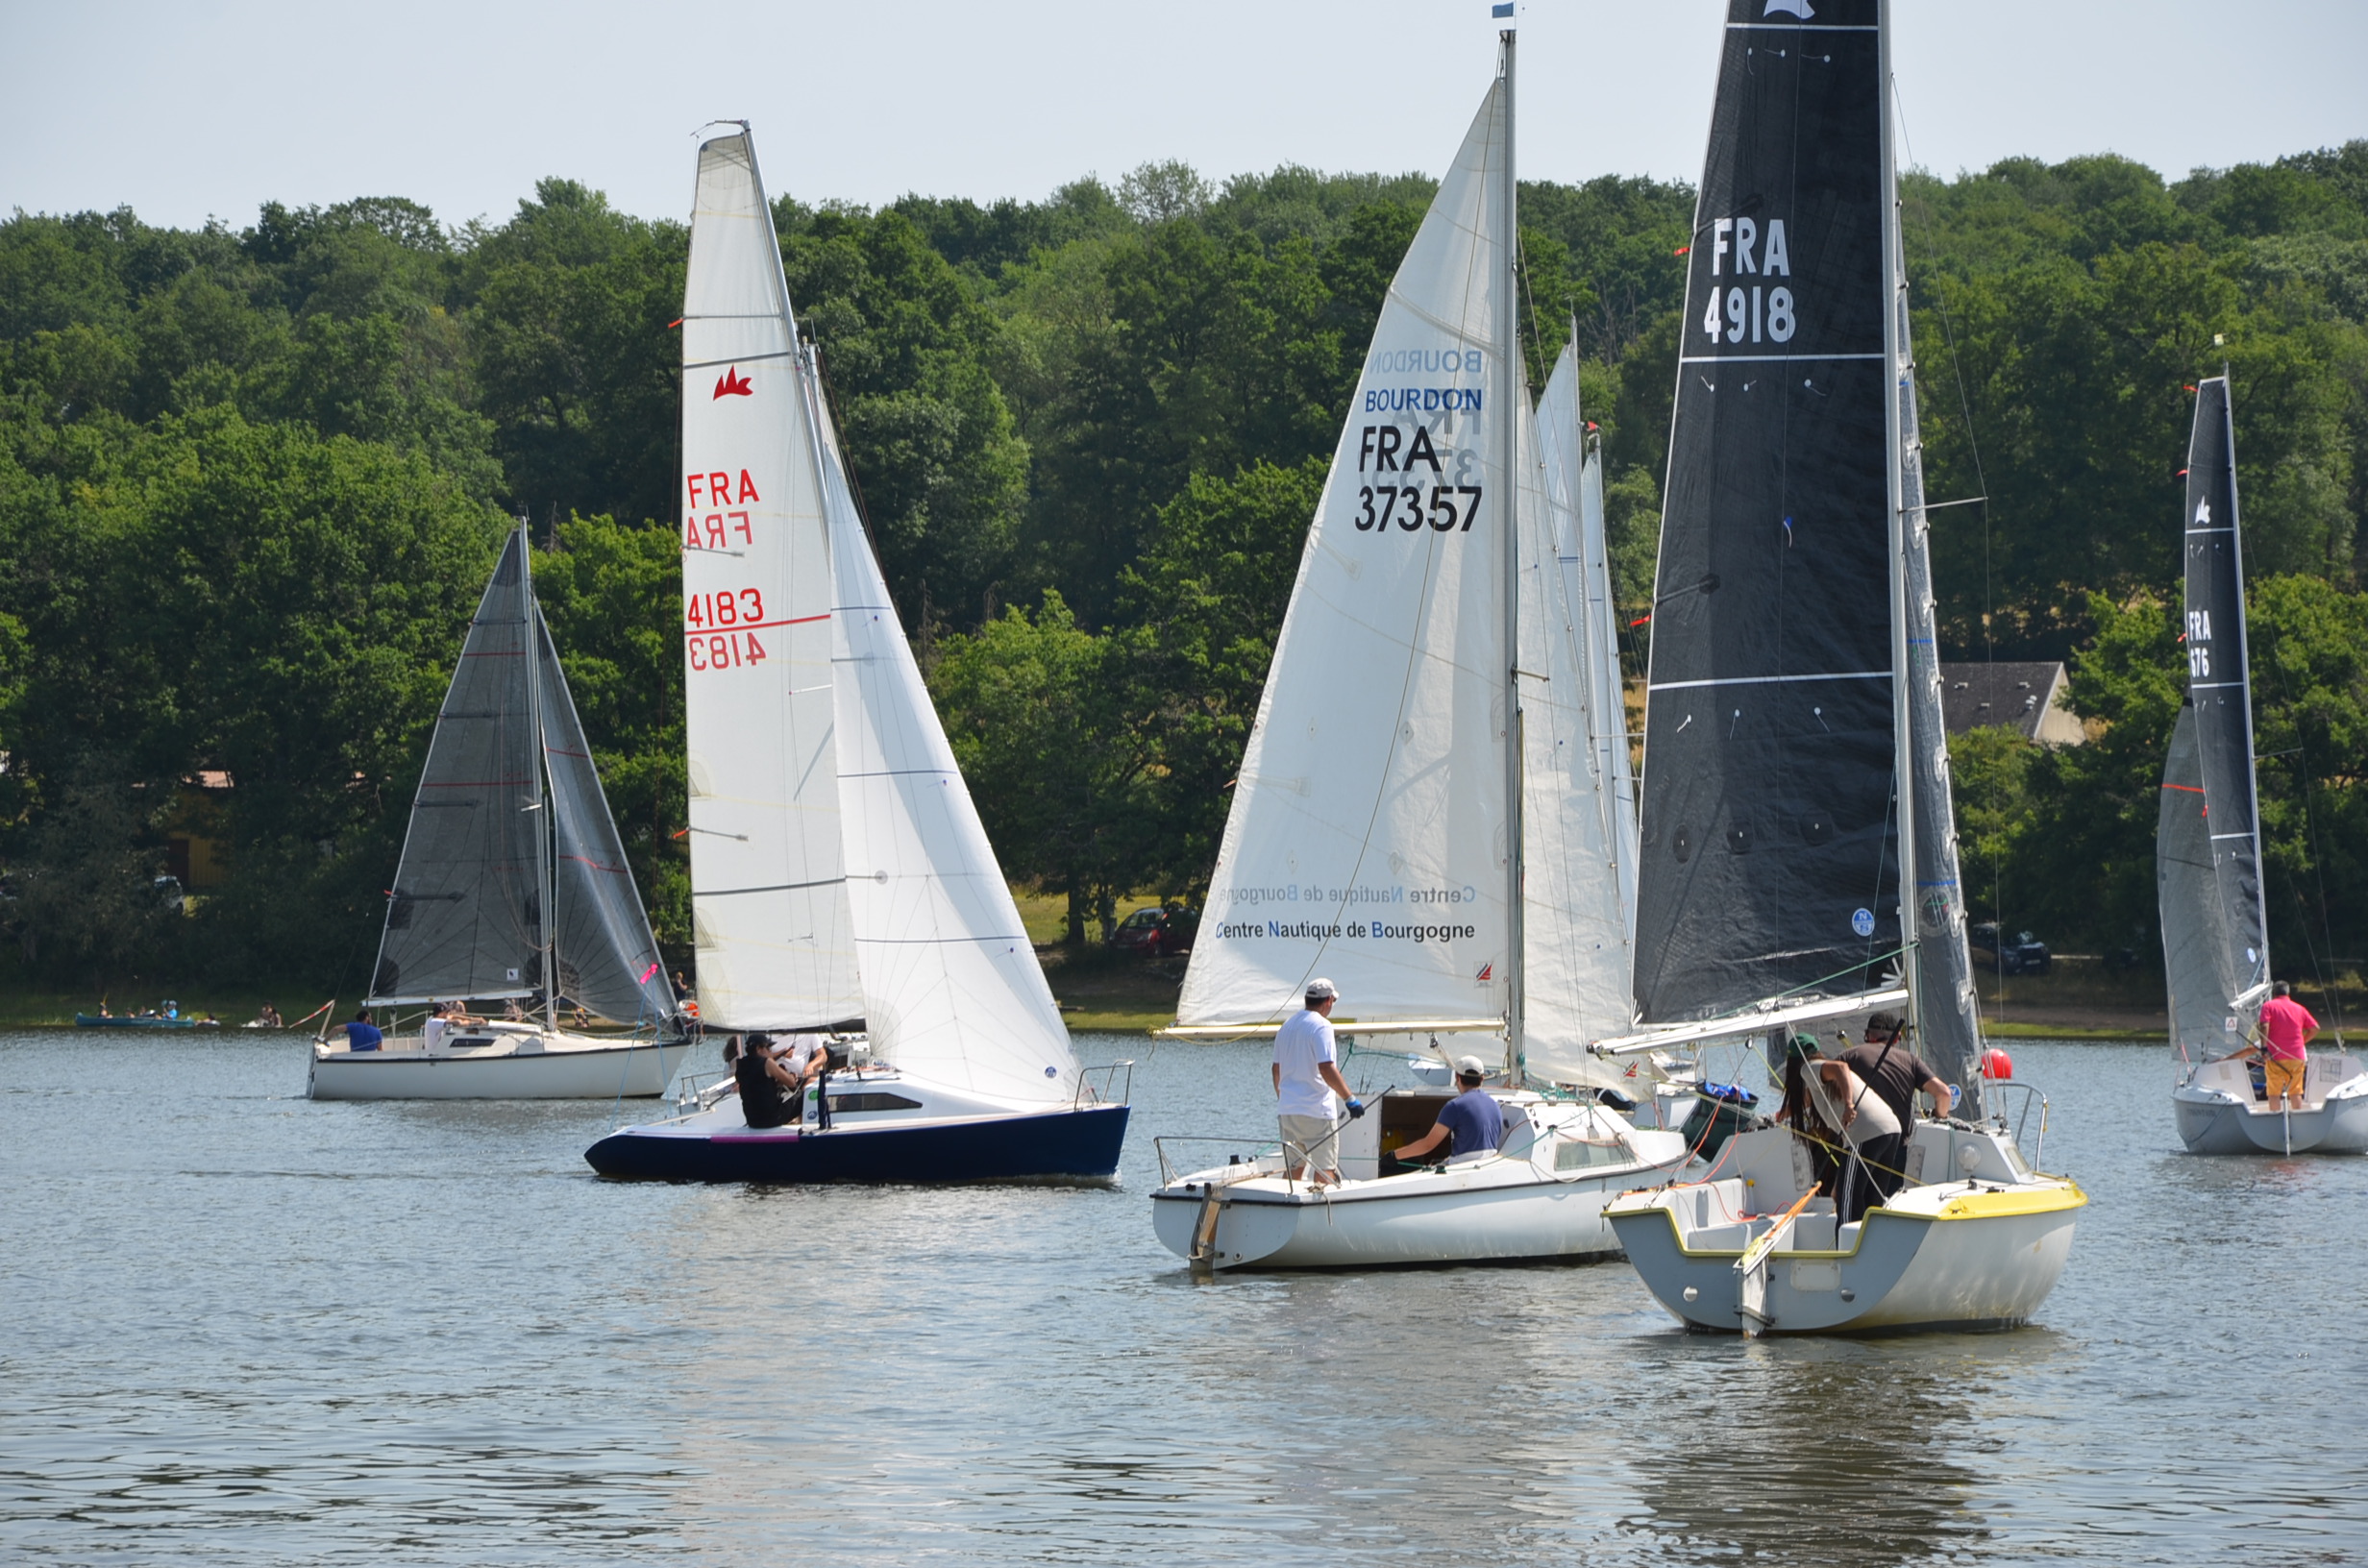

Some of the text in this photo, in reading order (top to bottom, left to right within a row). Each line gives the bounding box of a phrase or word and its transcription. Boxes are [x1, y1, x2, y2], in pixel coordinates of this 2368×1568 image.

[1713, 217, 1789, 276] FRA
[1704, 286, 1796, 344] 4918
[1366, 388, 1482, 412] BOURDON
[1359, 426, 1442, 472] FRA
[687, 469, 759, 508] FRA
[1355, 485, 1482, 532] 37357
[687, 588, 764, 627] 4183
[2188, 610, 2211, 642] FRA
[1216, 920, 1475, 943] Centre Nautique de Bourgogne
